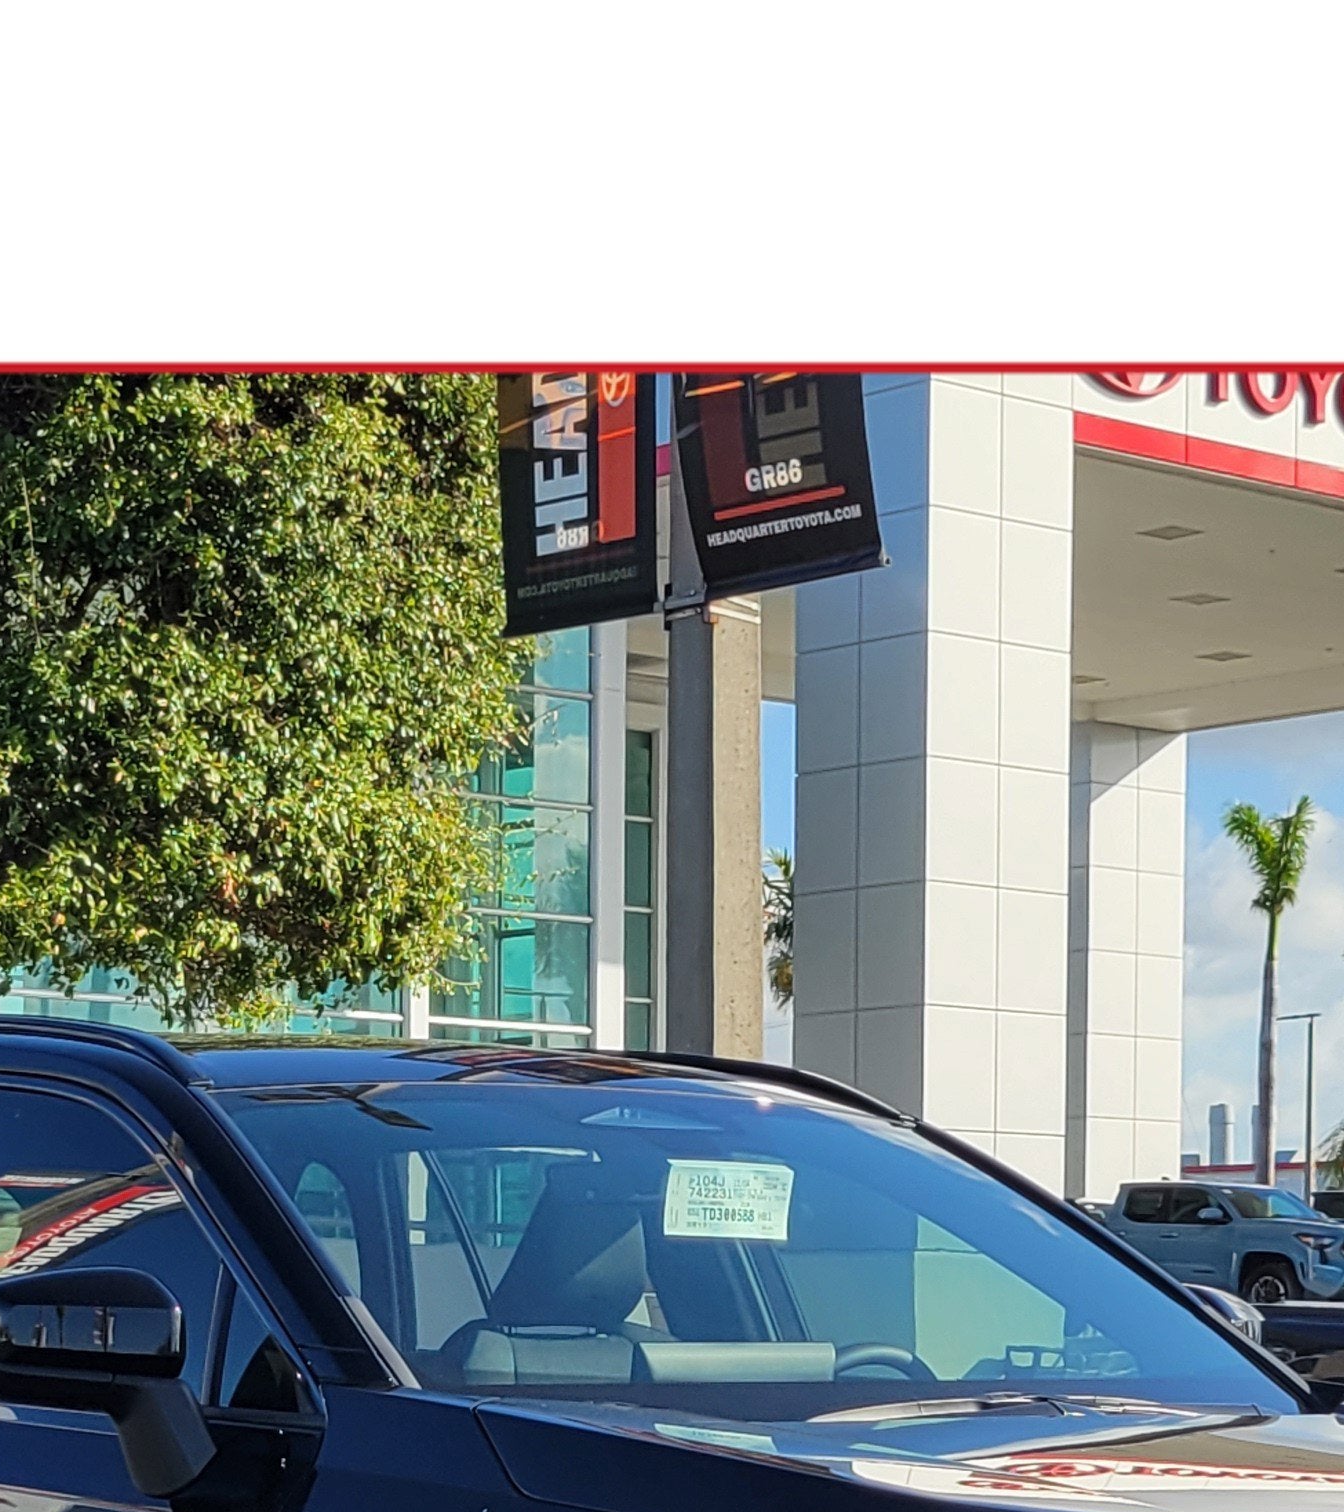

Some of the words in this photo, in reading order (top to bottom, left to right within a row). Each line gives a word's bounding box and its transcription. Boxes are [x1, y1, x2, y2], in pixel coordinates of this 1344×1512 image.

[745, 458, 804, 493] GR86
[707, 504, 863, 548] HEADQUARTERTOYOTA.COM
[689, 1187, 733, 1200] 742231
